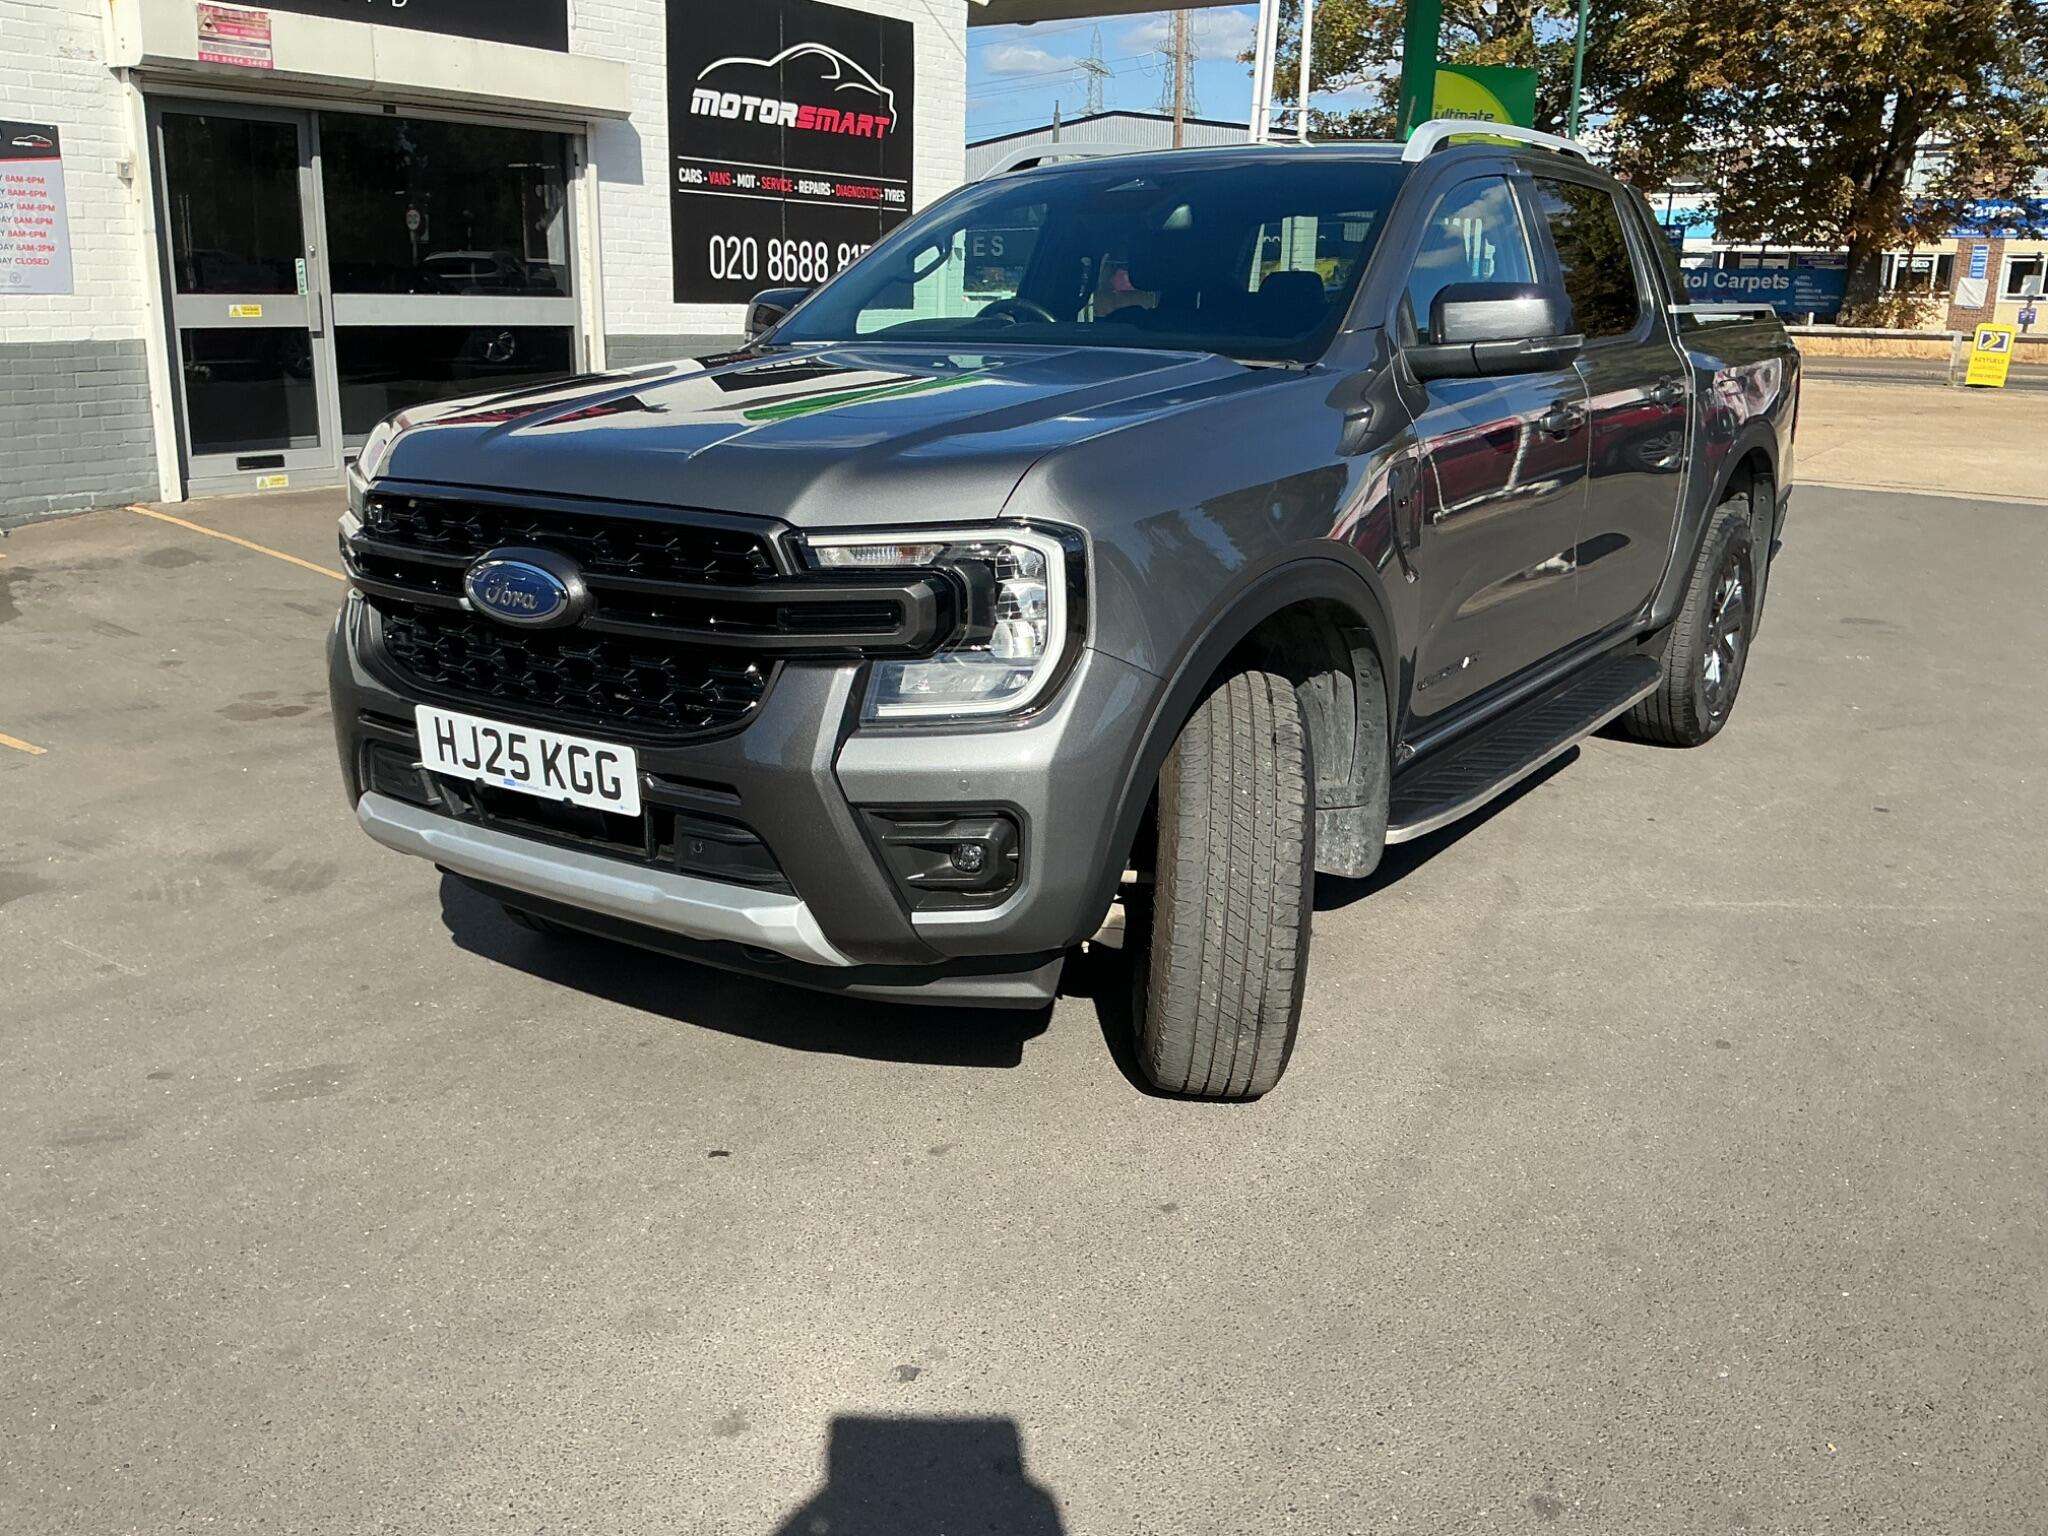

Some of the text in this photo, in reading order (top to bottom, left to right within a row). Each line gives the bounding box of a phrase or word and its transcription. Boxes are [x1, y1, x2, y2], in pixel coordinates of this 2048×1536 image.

[690, 88, 890, 138] MOTORSMART
[1435, 108, 1494, 120] ultimate
[678, 167, 906, 203] CARS VANS MOT SERVICE REPAIRS DIAGNOSTICS TYRES
[14, 257, 50, 266] CLOSED
[709, 235, 759, 280] 020
[767, 238, 829, 283] 8688
[1713, 271, 1791, 292] Carpets
[480, 570, 540, 610] Ford
[434, 716, 622, 801] HJ25 KGG
